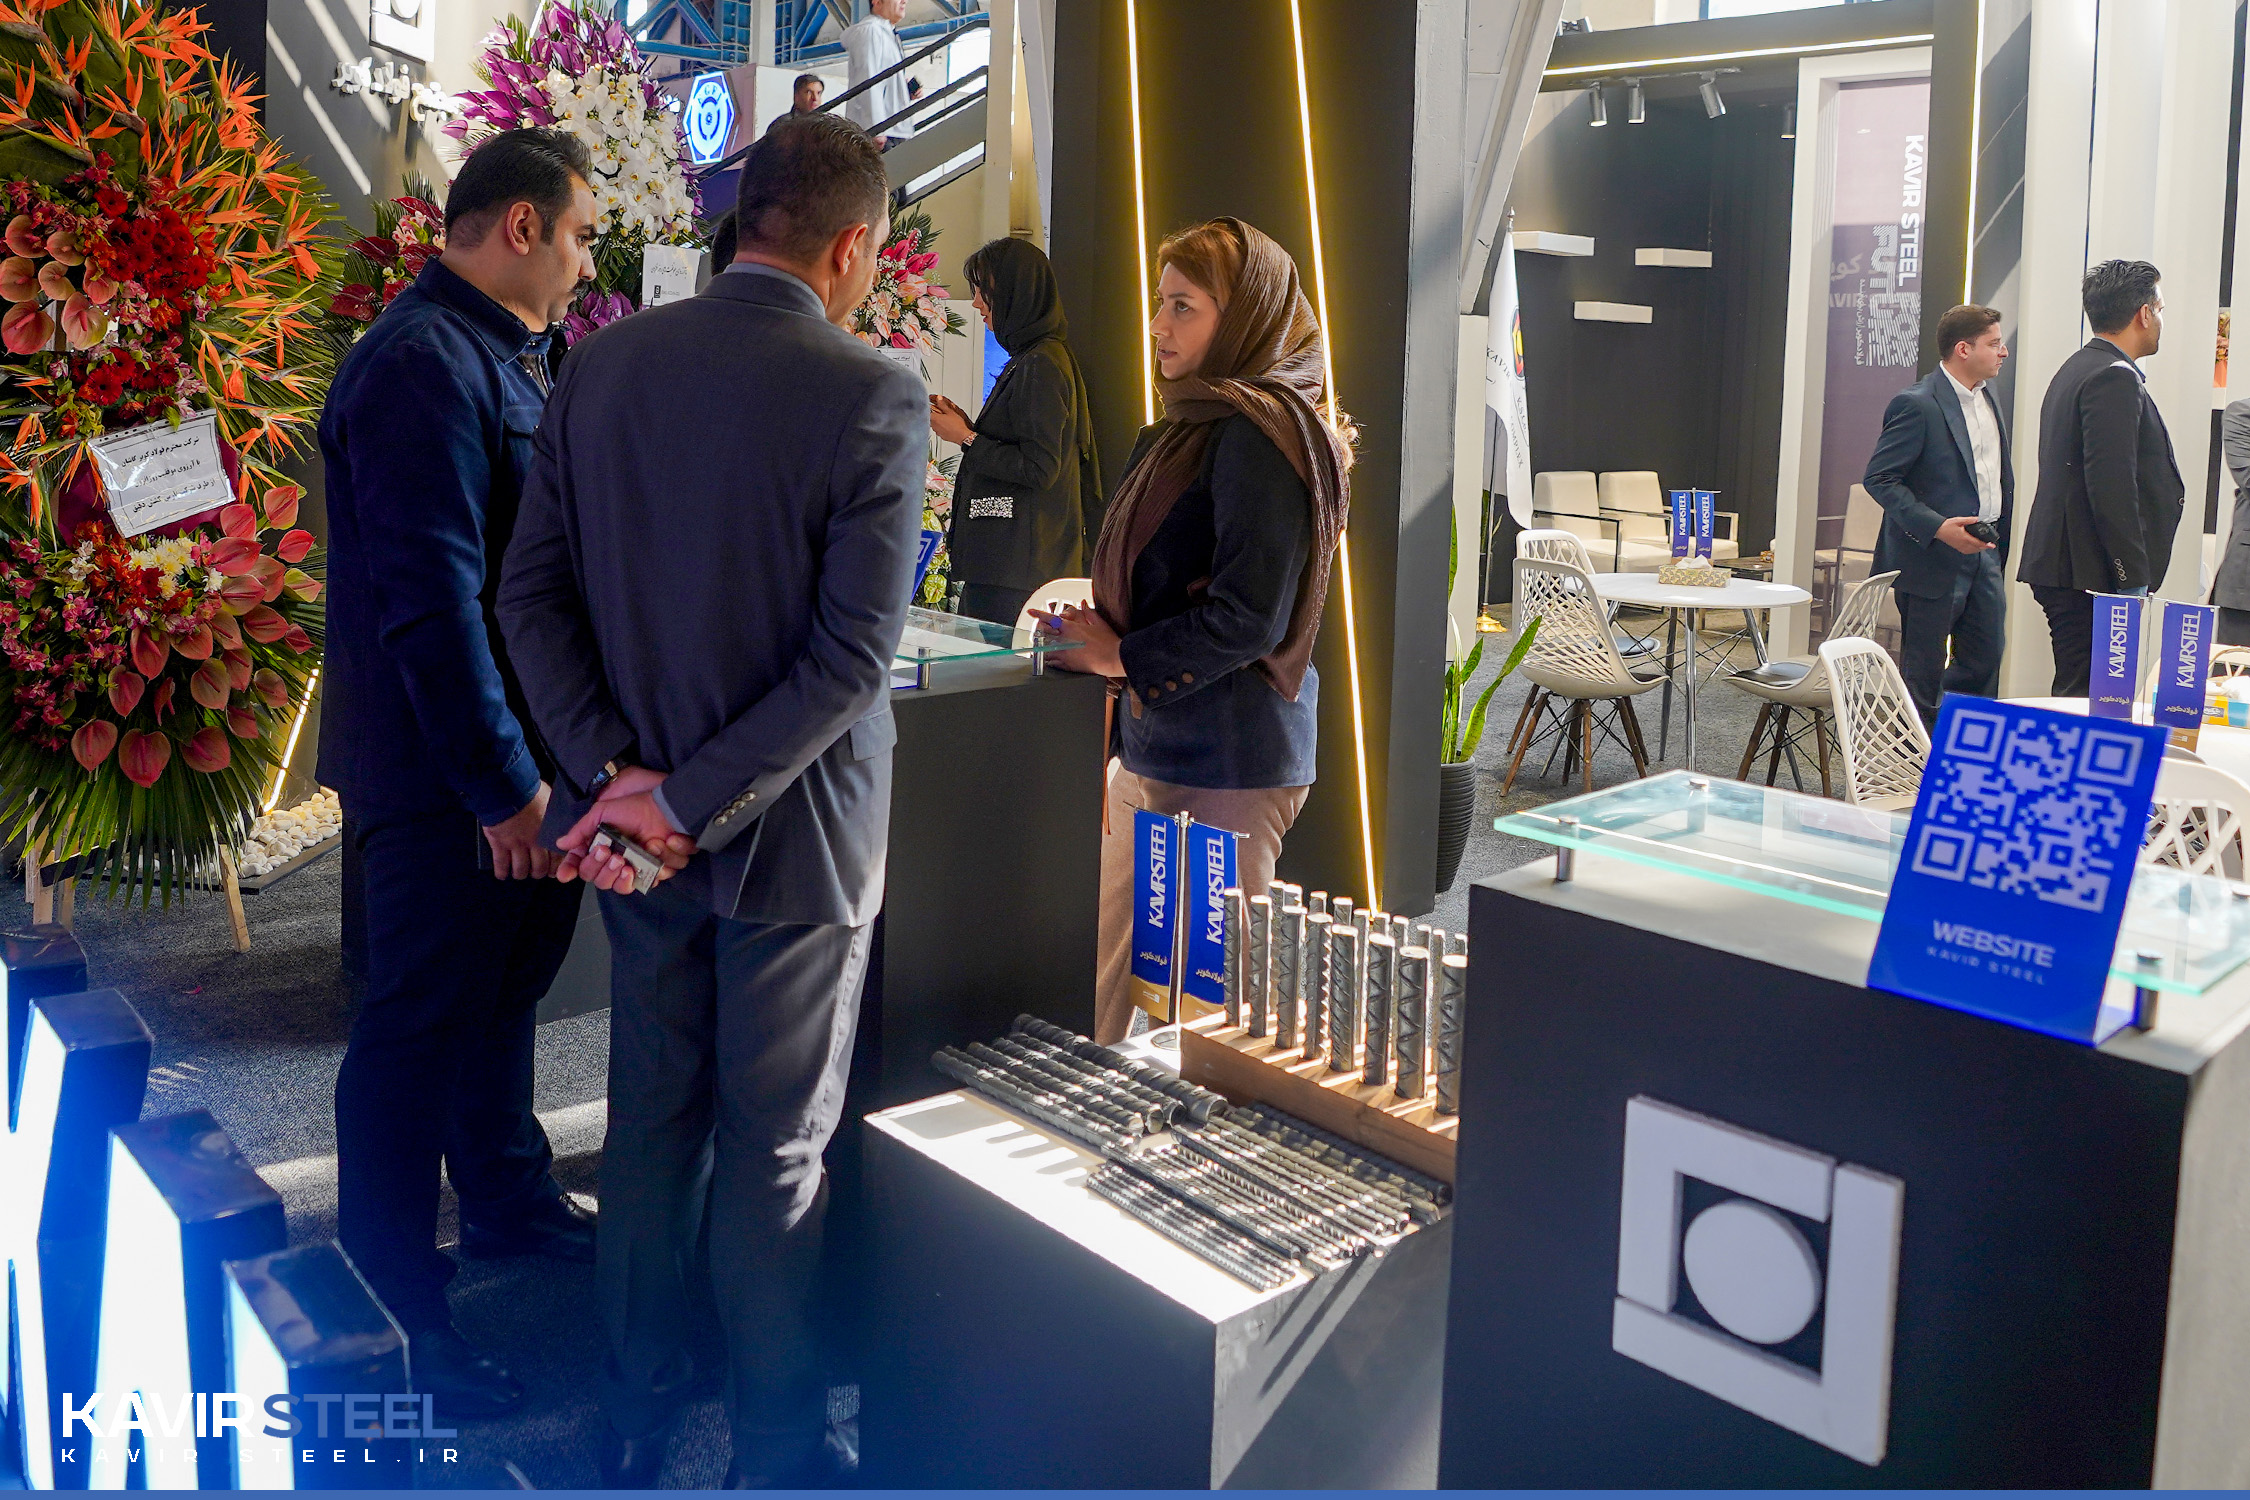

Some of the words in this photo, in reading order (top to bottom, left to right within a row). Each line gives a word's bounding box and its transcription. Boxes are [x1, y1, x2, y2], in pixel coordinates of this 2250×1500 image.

[1902, 134, 1925, 207] KAVIR
[1898, 212, 1920, 287] STEEL
[1487, 345, 1511, 382] KAVIR
[165, 442, 183, 453] محترم
[184, 437, 200, 447] شرکت
[138, 451, 150, 463] کویر
[151, 447, 165, 457] فولاد
[121, 455, 137, 467] کاشان
[177, 460, 195, 474] آرزوی
[1932, 919, 2056, 968] WEBSITE
[1926, 946, 1980, 967] KAVIR
[1988, 960, 2045, 986] STEEL
